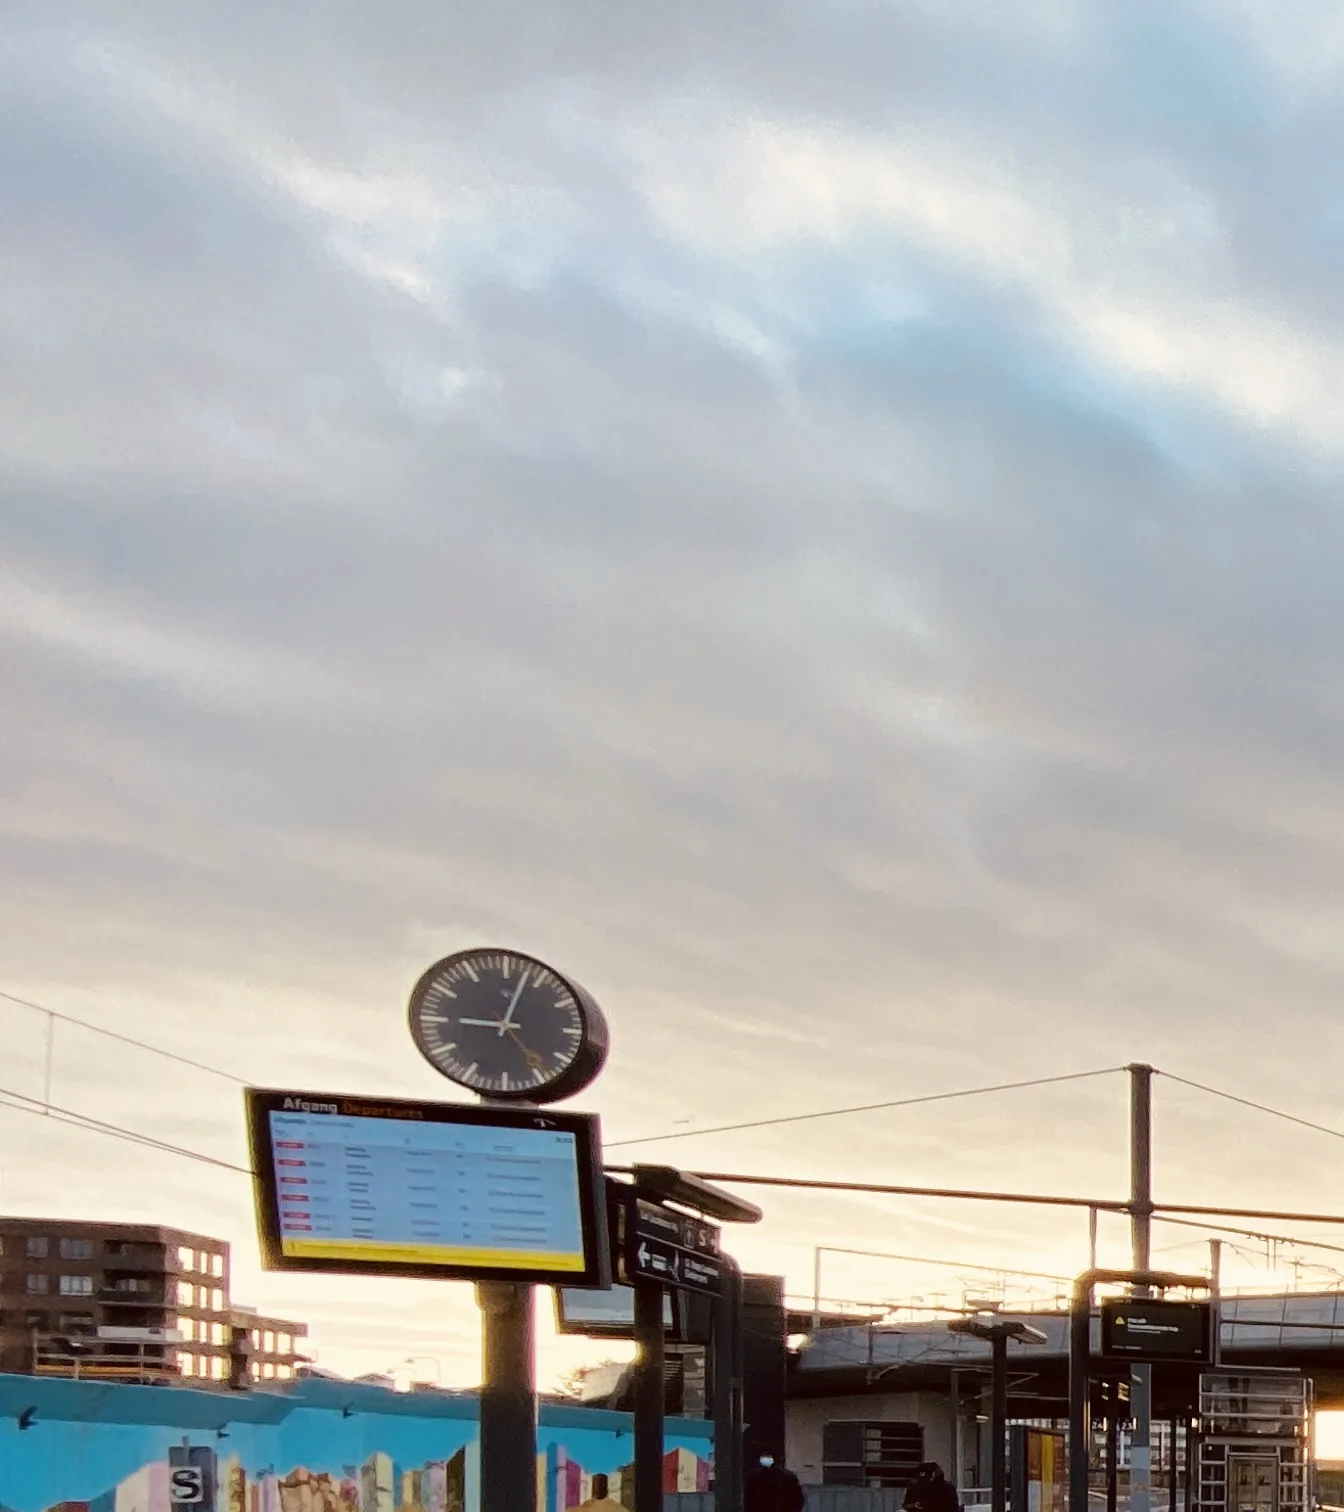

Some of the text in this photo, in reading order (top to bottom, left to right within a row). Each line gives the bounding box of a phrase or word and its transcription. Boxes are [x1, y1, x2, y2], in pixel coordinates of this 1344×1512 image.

[283, 1097, 424, 1120] Afgang Departures
[172, 1469, 200, 1500] S
